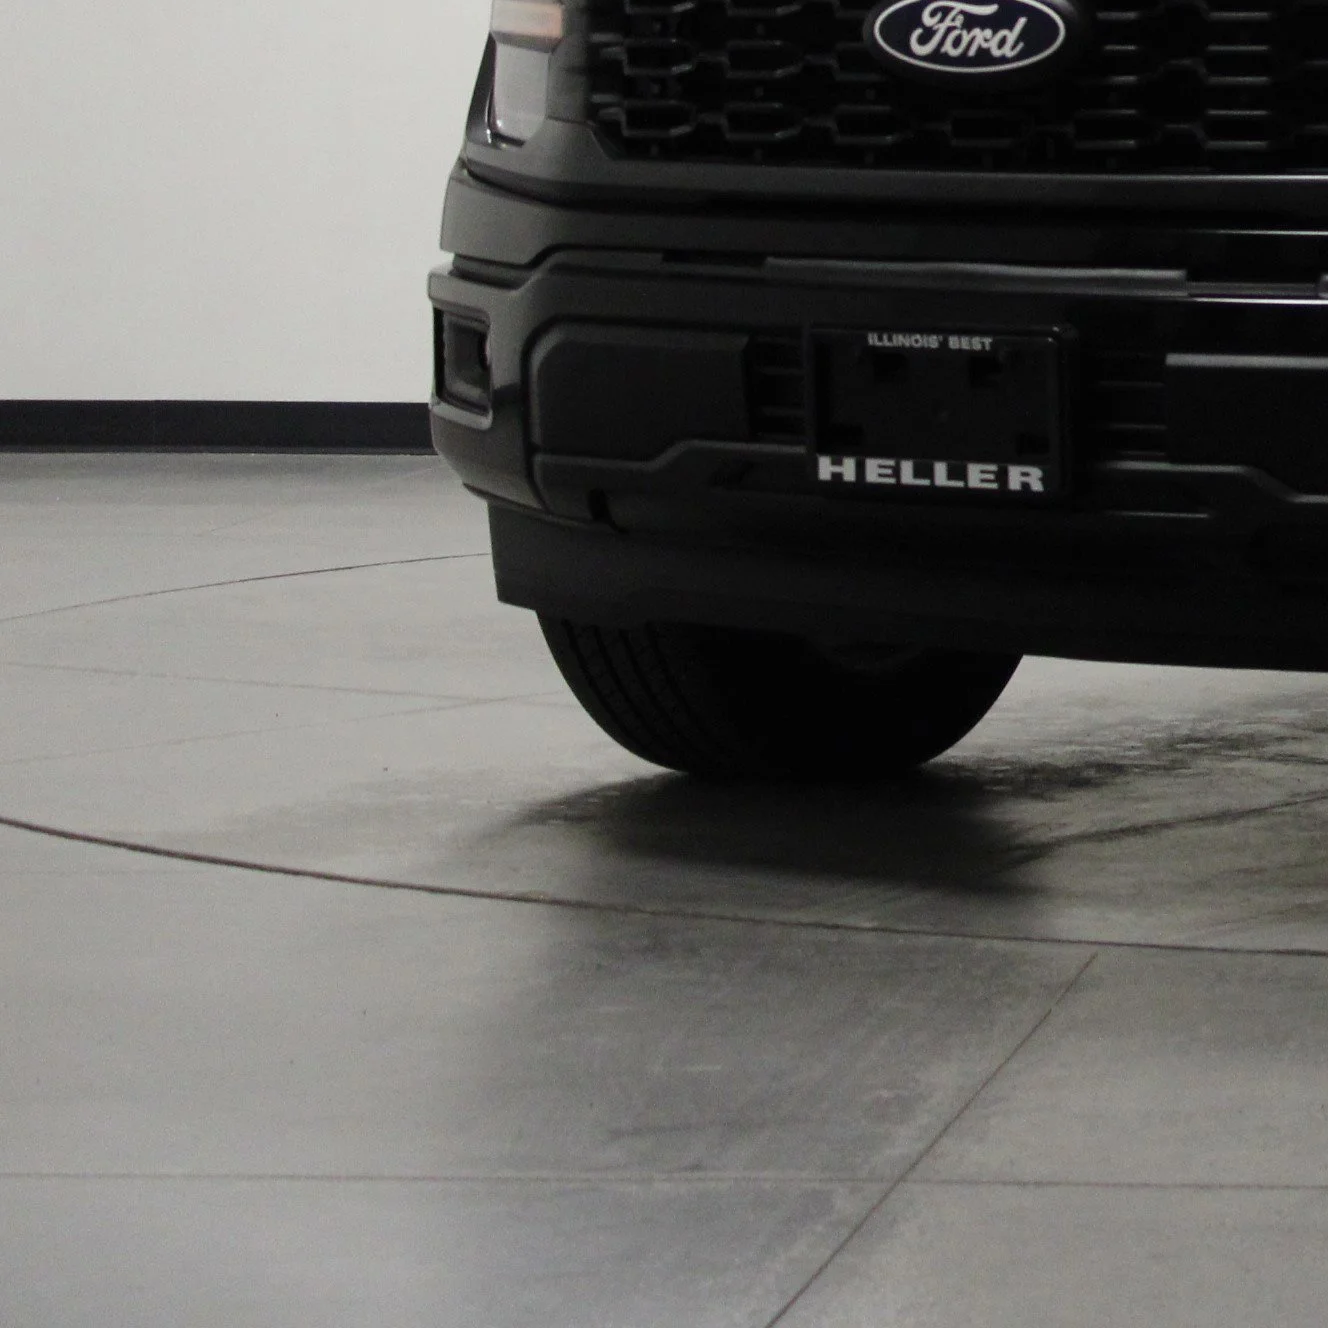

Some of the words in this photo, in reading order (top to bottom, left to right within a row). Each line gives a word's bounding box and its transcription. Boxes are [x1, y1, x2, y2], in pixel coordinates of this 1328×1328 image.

[909, 0, 1028, 58] Ford
[868, 332, 943, 349] ILLINOIS'
[948, 336, 993, 351] BEST
[817, 455, 1044, 492] HELLER
